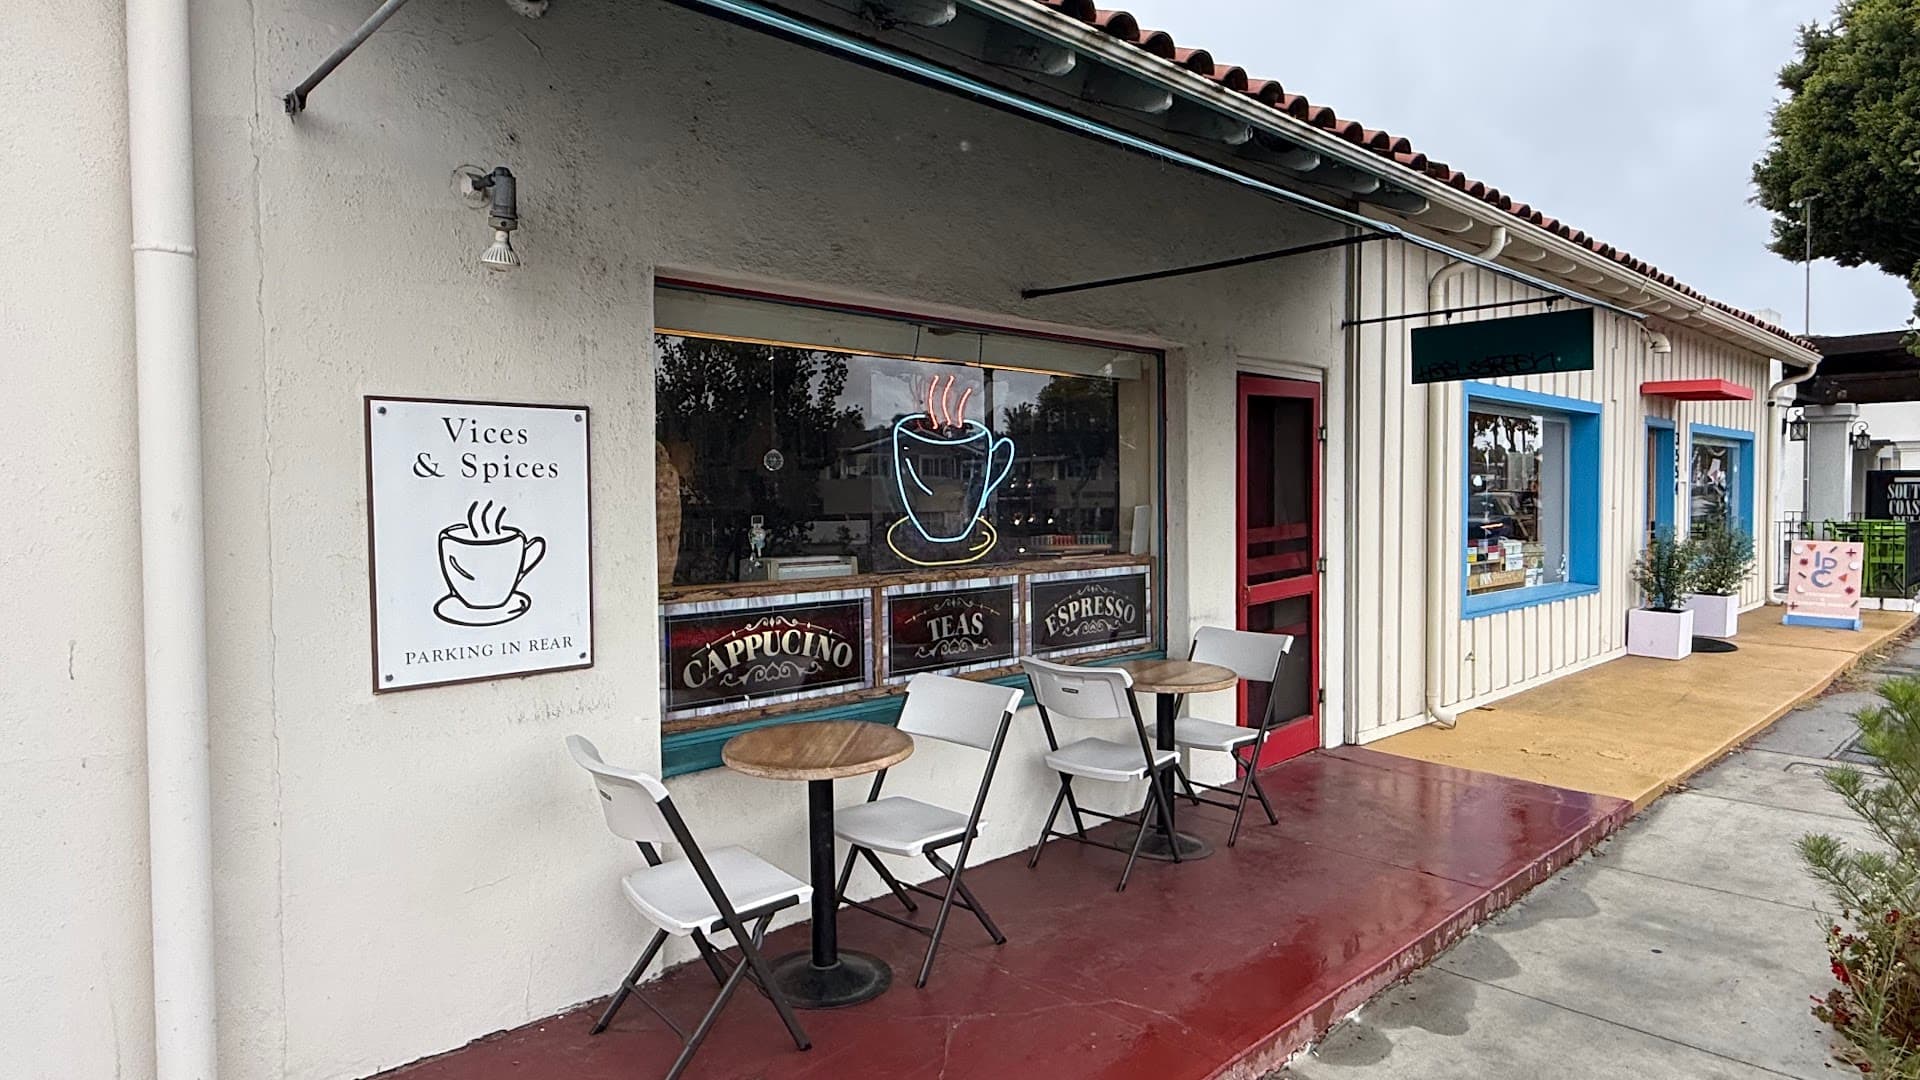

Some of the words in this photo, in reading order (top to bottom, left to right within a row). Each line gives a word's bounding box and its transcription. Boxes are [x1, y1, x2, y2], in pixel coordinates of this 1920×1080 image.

[442, 417, 528, 445] Vices
[413, 452, 445, 478] &
[460, 453, 559, 483] Spices
[1886, 484, 1920, 499] SOUT
[1889, 499, 1920, 515] COAS
[927, 611, 985, 642] TEAS
[1044, 593, 1137, 637] ESPRESSO
[405, 644, 494, 666] PARKING
[501, 639, 521, 655] IN
[529, 634, 573, 653] REAR
[682, 628, 854, 690] CAPPUCINO
